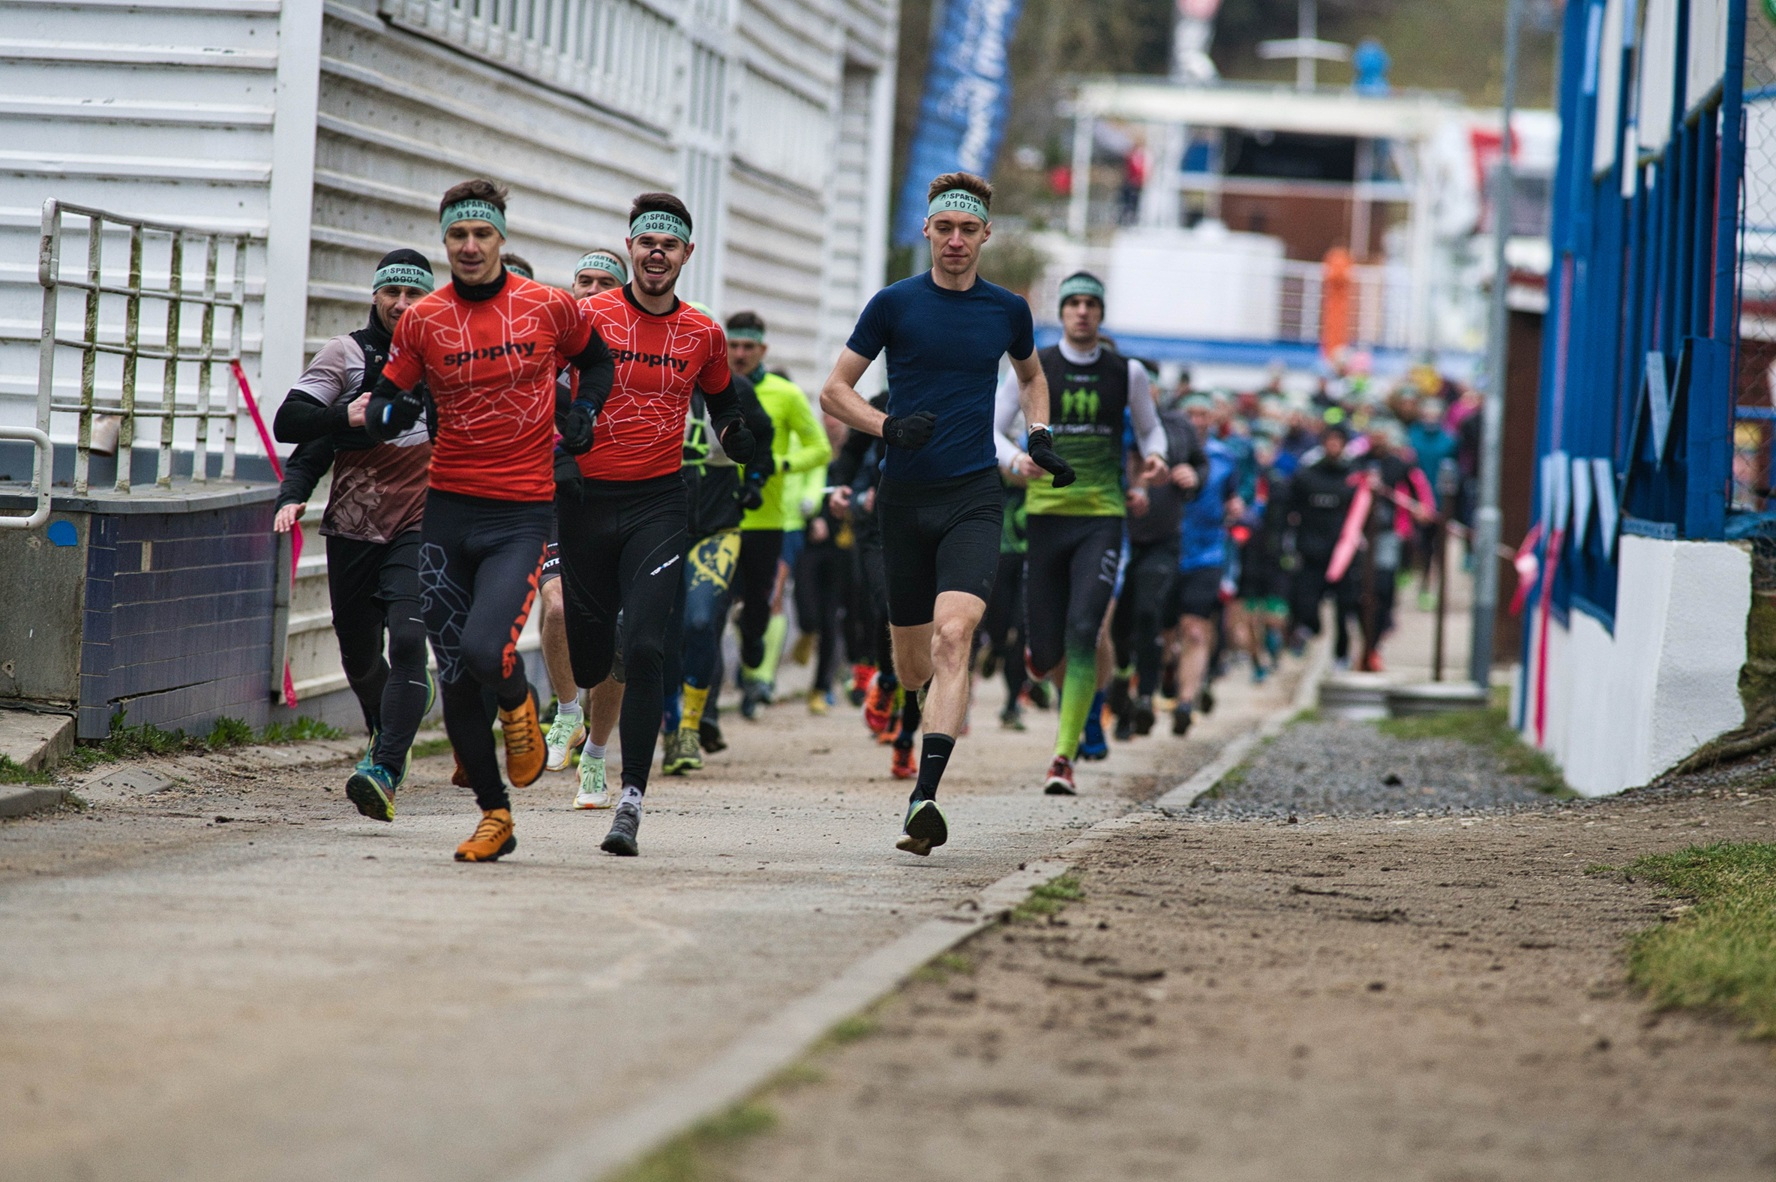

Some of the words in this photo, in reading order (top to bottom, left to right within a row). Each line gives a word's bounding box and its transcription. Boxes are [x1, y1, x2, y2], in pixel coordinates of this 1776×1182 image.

[950, 193, 981, 205] SPARTAN
[461, 201, 495, 212] SPARTAN
[945, 200, 978, 212] 91075
[456, 209, 492, 220] 91220
[650, 213, 683, 227] SPARTAN
[645, 222, 679, 234] 90873
[389, 267, 425, 278] SPARTAN
[443, 341, 537, 368] spophy
[609, 347, 689, 373] spophy
